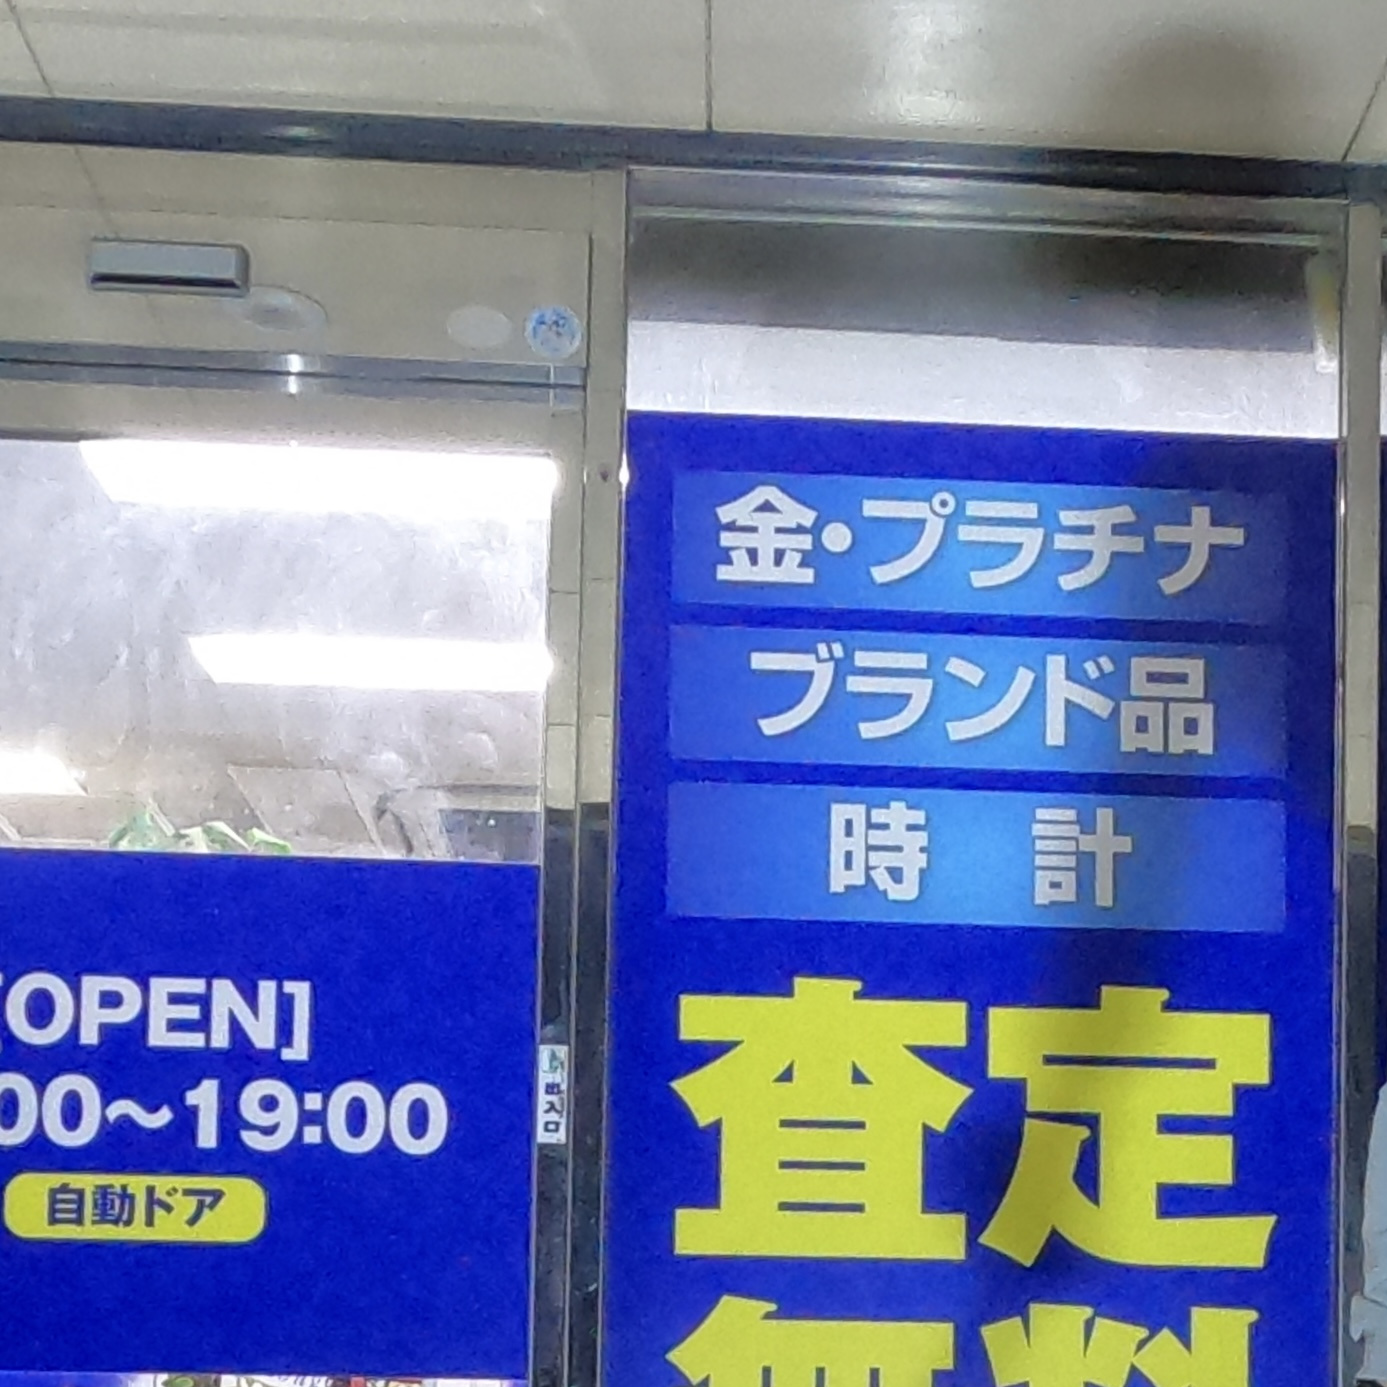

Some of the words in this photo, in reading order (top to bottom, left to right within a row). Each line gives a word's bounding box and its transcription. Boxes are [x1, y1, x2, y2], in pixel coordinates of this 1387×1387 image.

[749, 642, 1214, 755] ブランド品
[0, 971, 312, 1061] OPEN]
[668, 976, 1277, 1267] 査定
[46, 1182, 227, 1228] 自動ドア
